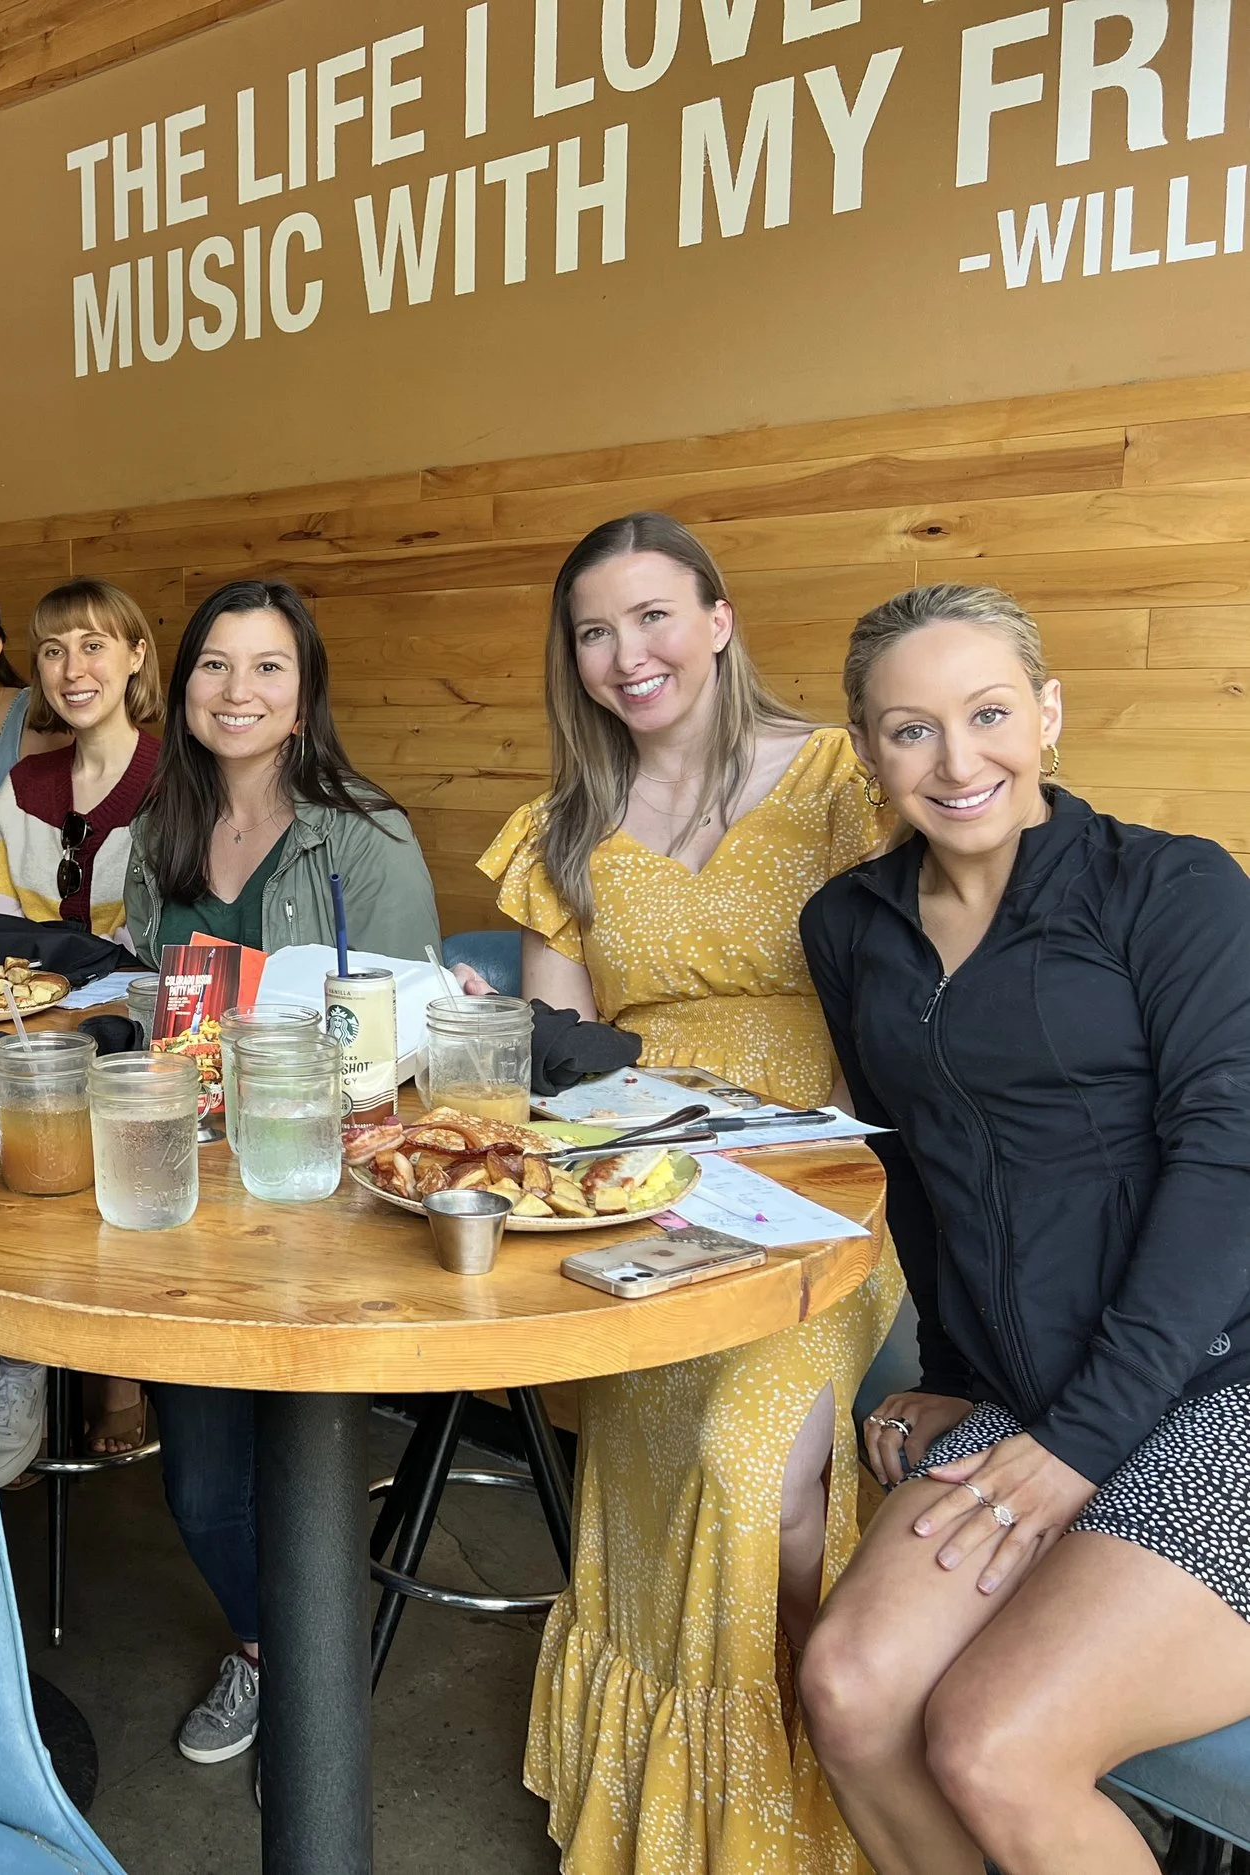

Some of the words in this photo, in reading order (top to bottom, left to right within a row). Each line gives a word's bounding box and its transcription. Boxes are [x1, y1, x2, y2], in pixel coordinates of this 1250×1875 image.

[66, 104, 208, 251] THE
[237, 25, 425, 205] LIFE
[465, 2, 488, 139] I
[534, 0, 861, 118] LO
[73, 212, 323, 377] MUSIC
[354, 123, 628, 314] WITH
[679, 47, 903, 247] MY
